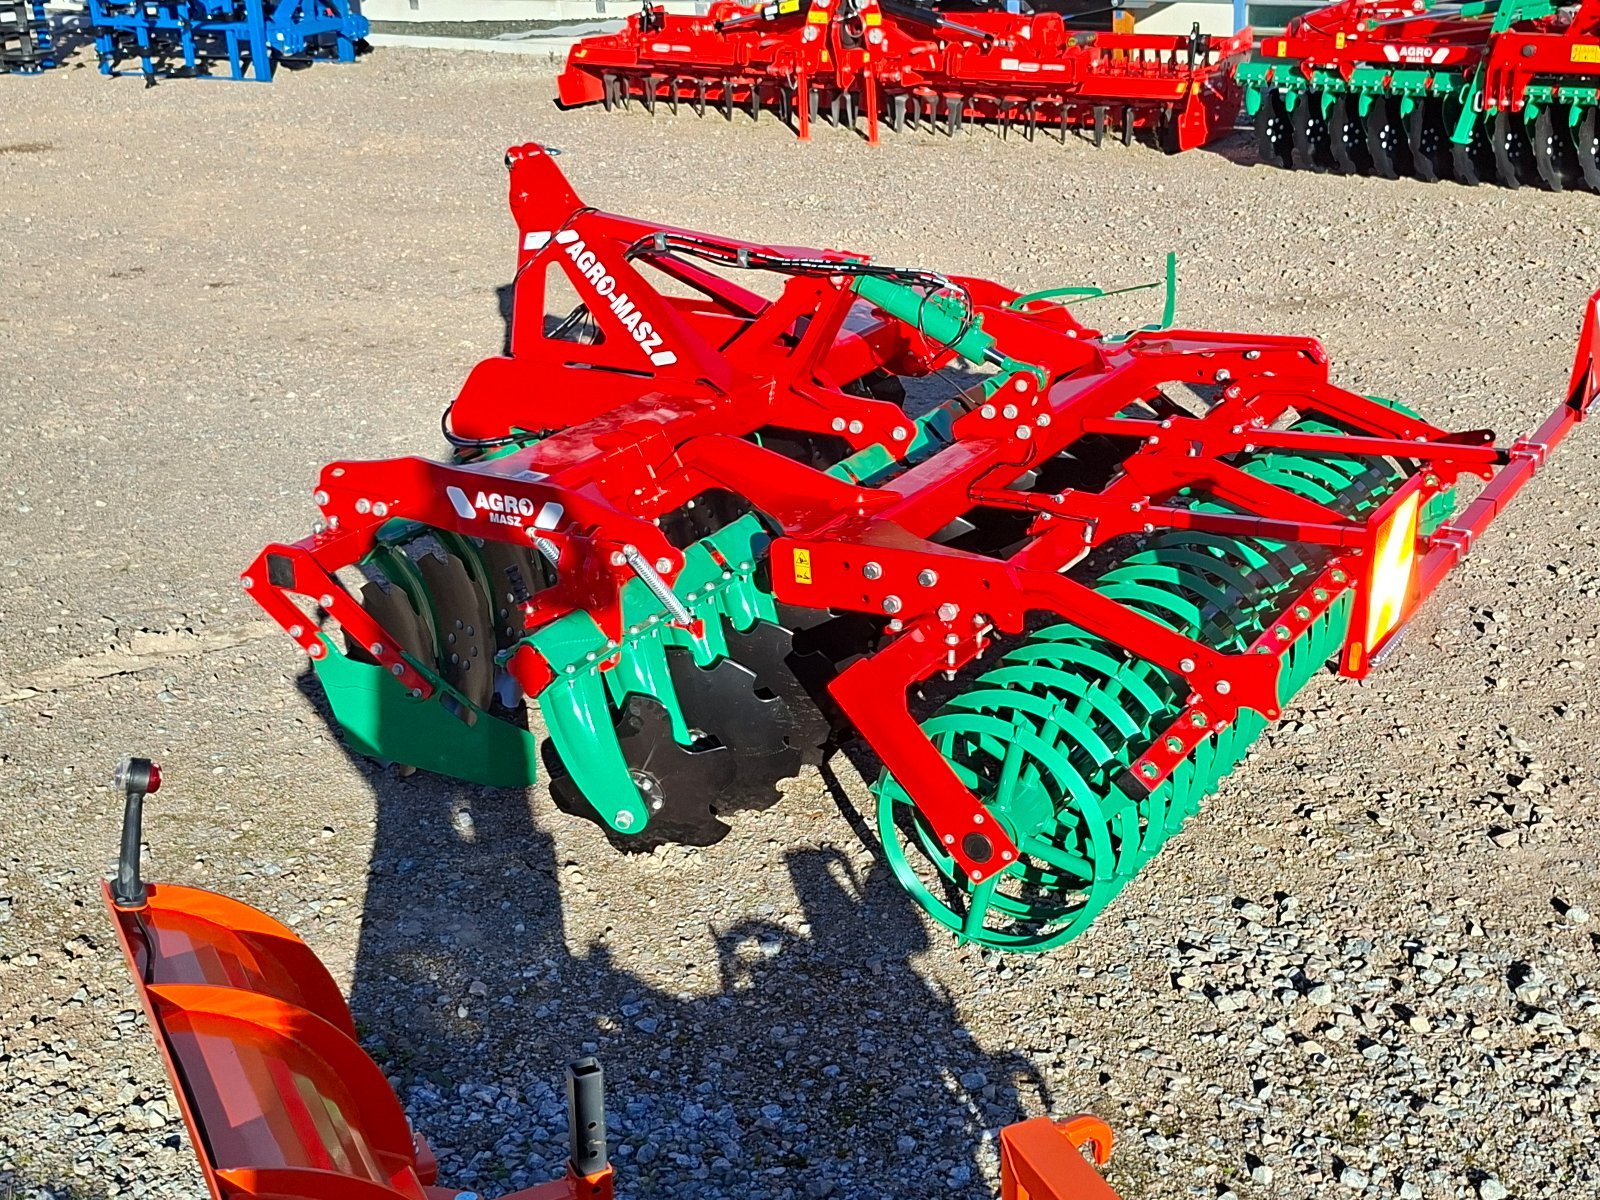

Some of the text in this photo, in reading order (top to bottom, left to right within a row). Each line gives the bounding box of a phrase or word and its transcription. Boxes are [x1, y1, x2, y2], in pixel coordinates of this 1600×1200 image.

[1400, 46, 1433, 57] AGRO
[565, 240, 663, 356] AGRO-MASZ
[475, 491, 534, 516] AGRO
[489, 512, 523, 527] MASZ
